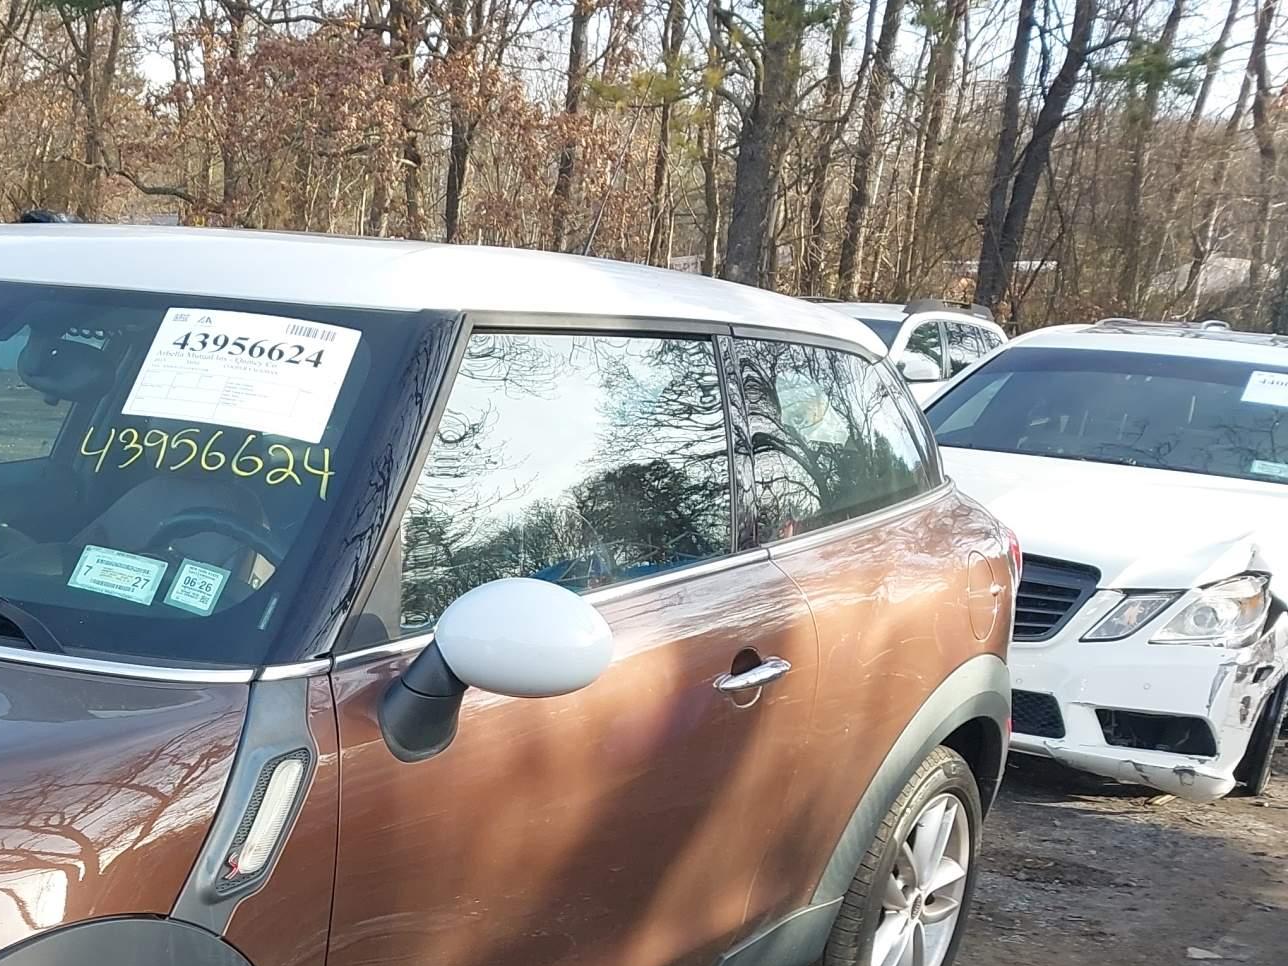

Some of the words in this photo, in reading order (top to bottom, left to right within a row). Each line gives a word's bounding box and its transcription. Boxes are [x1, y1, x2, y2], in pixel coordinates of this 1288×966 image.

[172, 331, 323, 368] 43956624
[81, 426, 336, 501] 43956624
[83, 565, 93, 576] 7
[132, 576, 151, 590] 27
[183, 575, 198, 588] 06
[198, 580, 213, 593] 26
